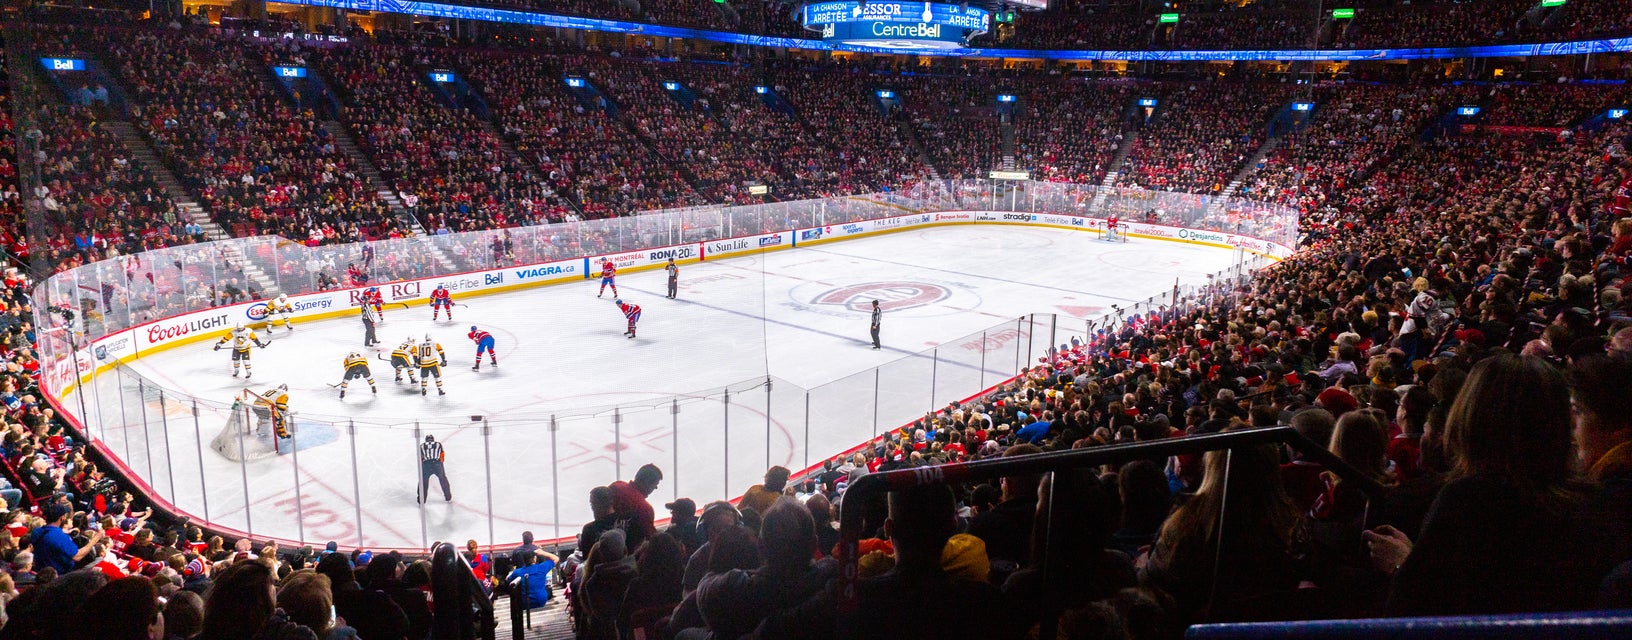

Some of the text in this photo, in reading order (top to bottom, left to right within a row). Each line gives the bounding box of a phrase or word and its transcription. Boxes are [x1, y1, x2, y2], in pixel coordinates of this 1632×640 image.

[820, 3, 847, 11] CHANSON
[965, 8, 980, 16] ANSON
[813, 11, 847, 23] ARRÊTÉE
[872, 21, 940, 38] CentreBell
[54, 59, 73, 69] Bell
[282, 67, 297, 77] Bell
[1003, 213, 1031, 222] stradigi
[1072, 218, 1084, 226] Bell
[1190, 231, 1223, 242] Desjardins
[716, 239, 748, 252] Sun Life
[614, 252, 645, 262] MONTRÉAL
[650, 249, 677, 260] RONA
[678, 248, 690, 258] 20
[460, 279, 479, 289] Fibe
[485, 272, 503, 285] Bell
[392, 282, 421, 297] RCI
[295, 298, 332, 311] Synergy
[250, 308, 264, 316] Ess
[147, 314, 228, 344] Coors LIGHT
[421, 346, 432, 357] 10
